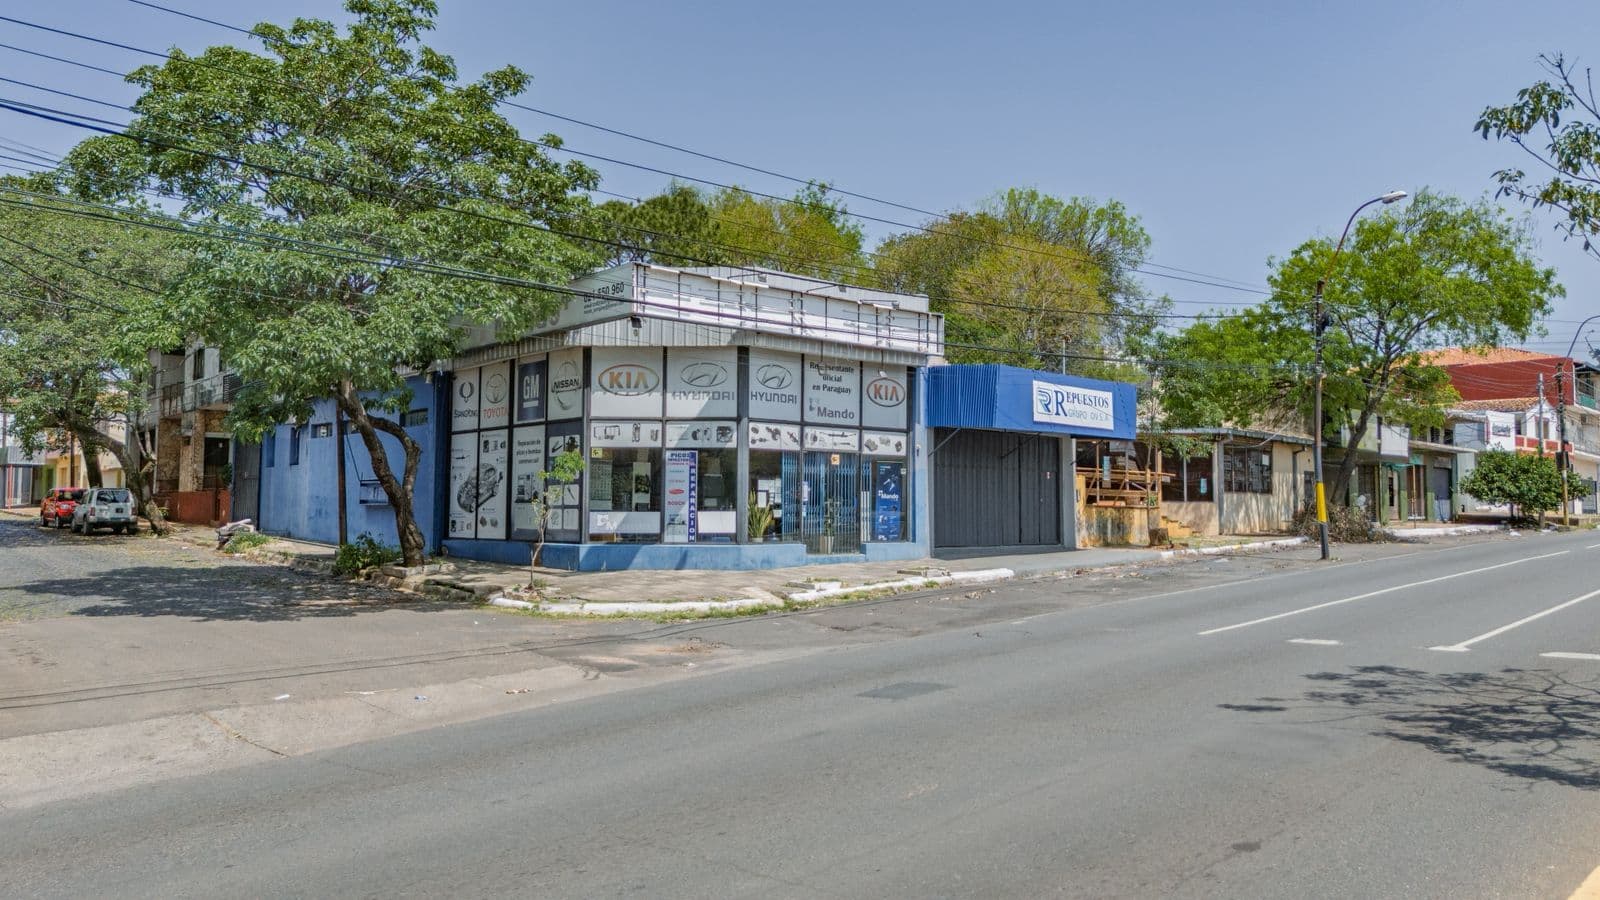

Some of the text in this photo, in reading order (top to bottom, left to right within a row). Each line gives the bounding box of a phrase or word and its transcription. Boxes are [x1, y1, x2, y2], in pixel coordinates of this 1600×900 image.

[611, 281, 624, 295] 960
[522, 374, 540, 399] GM
[553, 378, 580, 390] NISSAN
[609, 372, 649, 389] KIA
[672, 391, 735, 400] HYUNDAI
[822, 383, 851, 395] Paraguay
[873, 383, 900, 401] KIA
[751, 391, 798, 405] HYUNDAI
[1053, 390, 1110, 416] REPUESTOS
[817, 406, 855, 419] Mando
